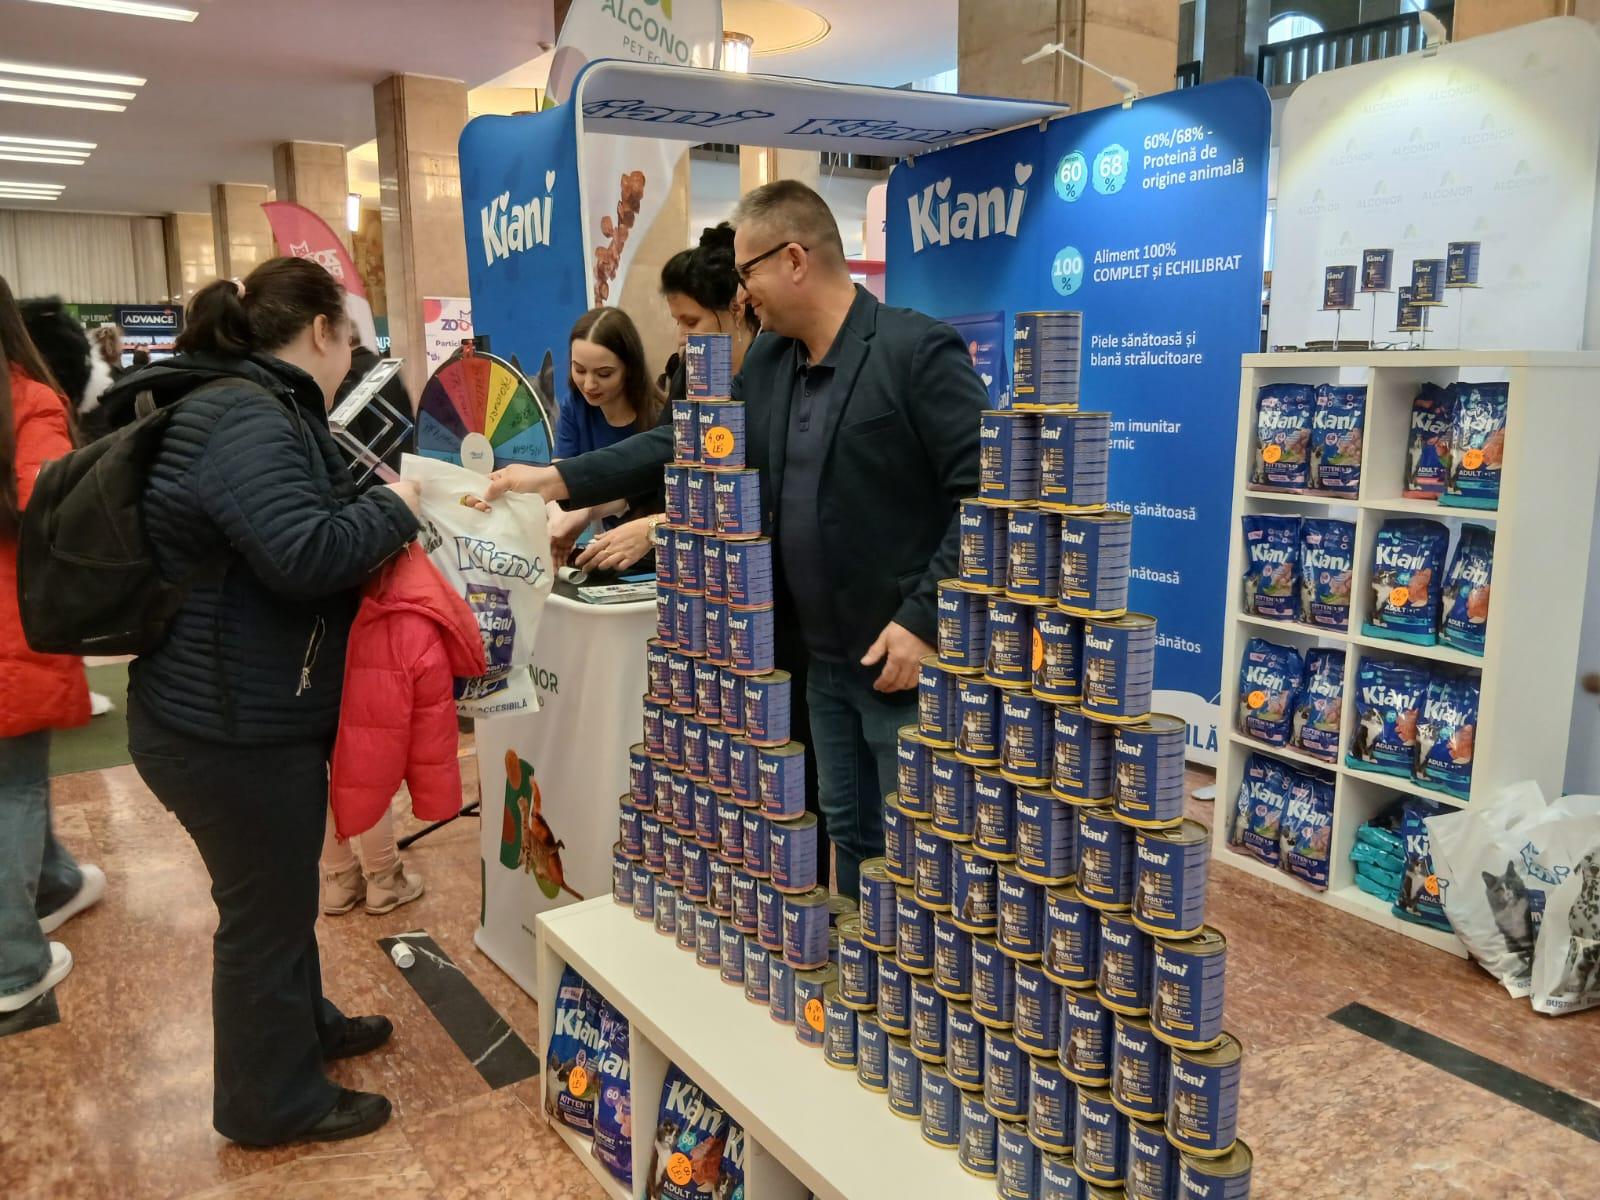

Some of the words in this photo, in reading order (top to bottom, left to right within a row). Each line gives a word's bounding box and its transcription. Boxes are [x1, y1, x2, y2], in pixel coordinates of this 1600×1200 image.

[601, 0, 689, 63] ALCONO
[622, 35, 644, 57] PET
[583, 99, 775, 128] iani
[1143, 126, 1205, 150] 60%/68%
[1099, 155, 1123, 177] 68
[1142, 147, 1198, 170] Proteină
[1200, 143, 1218, 160] de
[1060, 161, 1083, 183] 60
[1142, 168, 1187, 190] origine
[1189, 158, 1245, 184] animală
[480, 170, 556, 267] Kiani
[907, 162, 1033, 254] Kiani
[1093, 245, 1140, 264] Aliment
[1142, 241, 1177, 259] 100%
[1052, 255, 1082, 277] 100
[1093, 265, 1150, 283] COMPLET
[1164, 254, 1243, 276] ECHILIBRAT
[124, 315, 174, 324] ADVANCE
[435, 339, 462, 348] Partici
[1091, 333, 1118, 349] Piele
[1120, 331, 1183, 348] sănătoasă
[1090, 351, 1122, 367] blană
[1123, 350, 1203, 366] strălucitoare
[1109, 421, 1126, 433] em
[1128, 418, 1181, 434] imunitar
[1107, 435, 1136, 450] ernic
[1104, 501, 1131, 515] estie
[1133, 501, 1197, 521] sănătoasă
[454, 535, 546, 586] Kiani
[1129, 563, 1181, 585] nătoasă
[529, 663, 559, 695] NOR
[1185, 723, 1219, 753] ILĂ
[1419, 894, 1440, 904] ADUL
[606, 1088, 620, 1100] 60
[663, 1180, 691, 1199] ADULT
